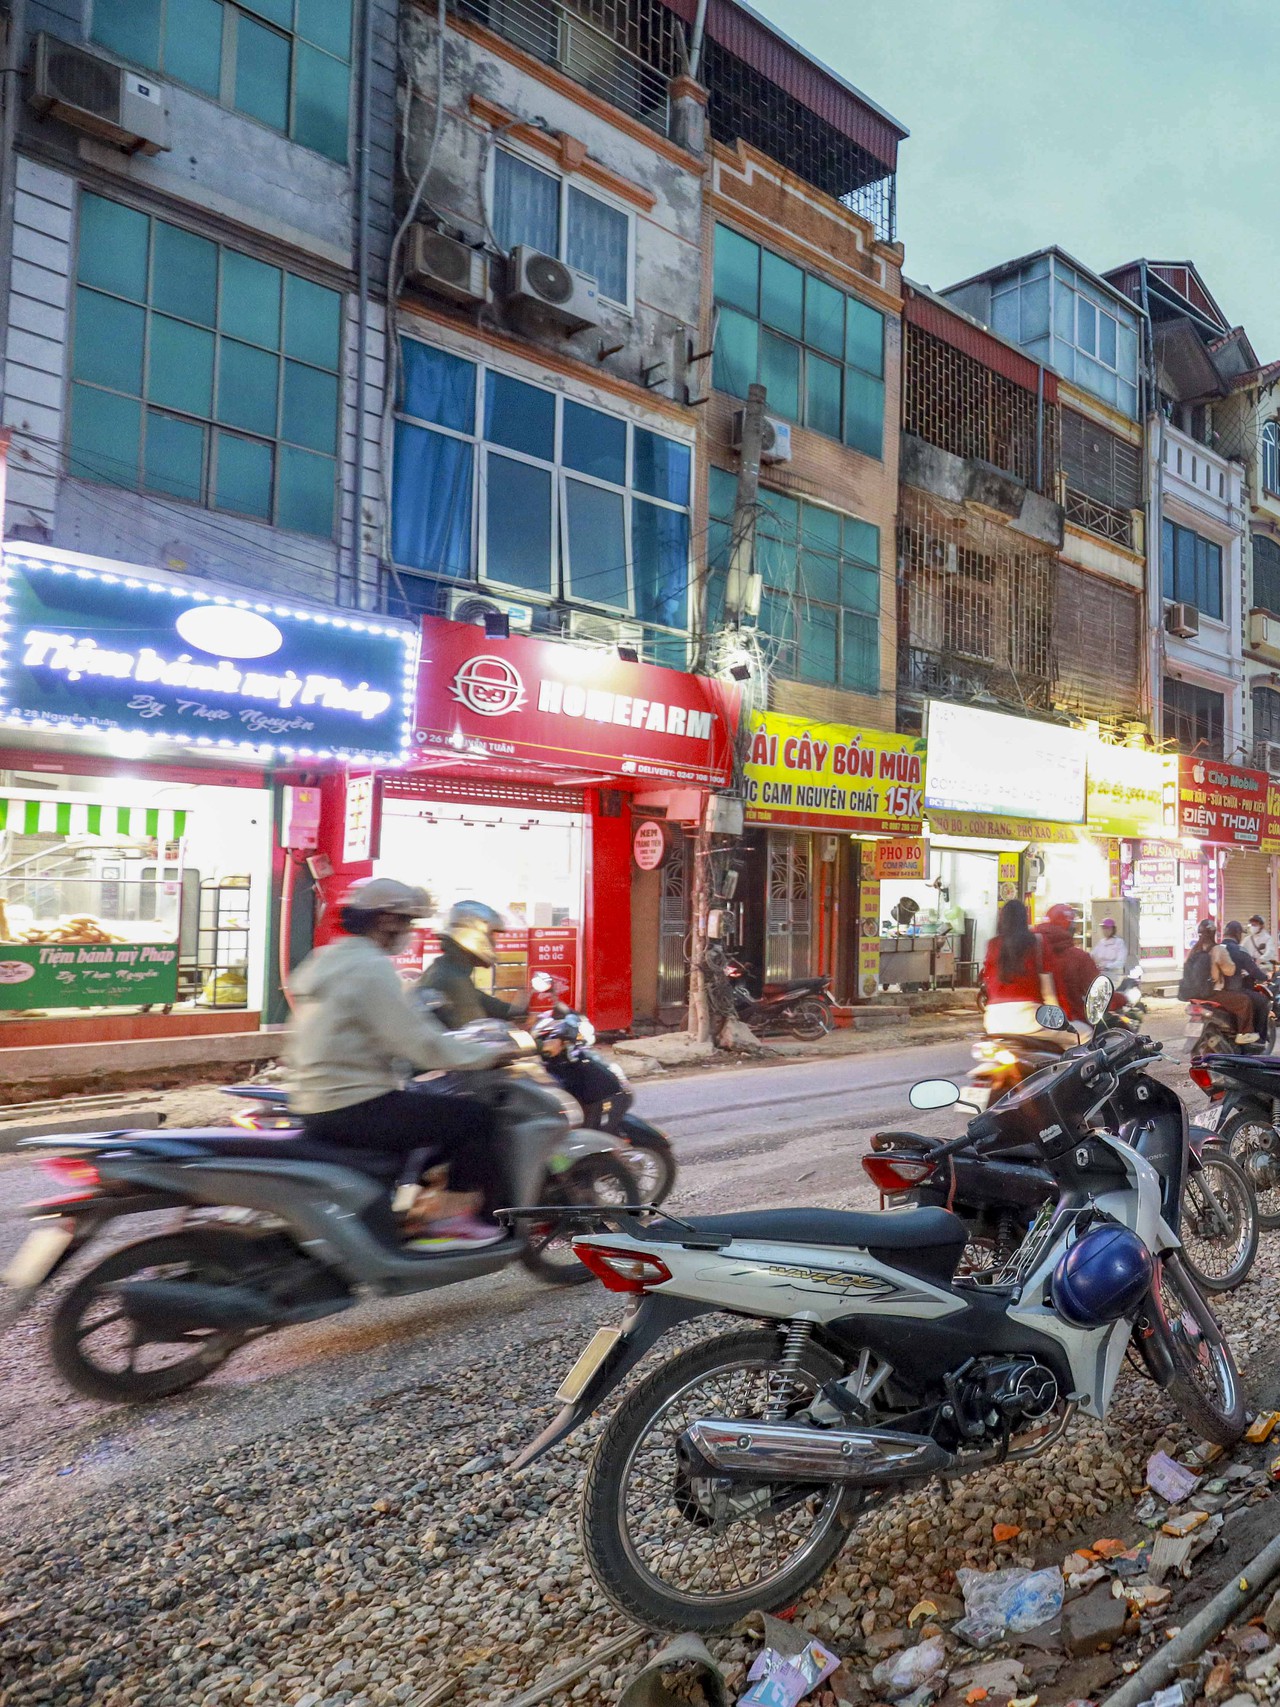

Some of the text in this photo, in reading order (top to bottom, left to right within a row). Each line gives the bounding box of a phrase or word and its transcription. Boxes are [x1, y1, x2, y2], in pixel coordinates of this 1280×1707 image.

[127, 694, 165, 719] By
[536, 679, 713, 740] HOMEFARM
[638, 764, 675, 777] DELIVERY:
[783, 730, 830, 773] CÂY
[832, 733, 876, 780] BỐN
[879, 747, 922, 785] MÙA
[762, 781, 792, 805] CAM
[796, 784, 846, 810] NGUYÊN
[850, 786, 879, 813] CHẤT
[884, 785, 922, 819] 15K
[1183, 805, 1217, 827] ĐIỆN
[1220, 812, 1260, 834] THOẠI
[39, 948, 75, 968] Tiệm
[77, 947, 115, 964] bánh
[140, 946, 176, 965] Pháp
